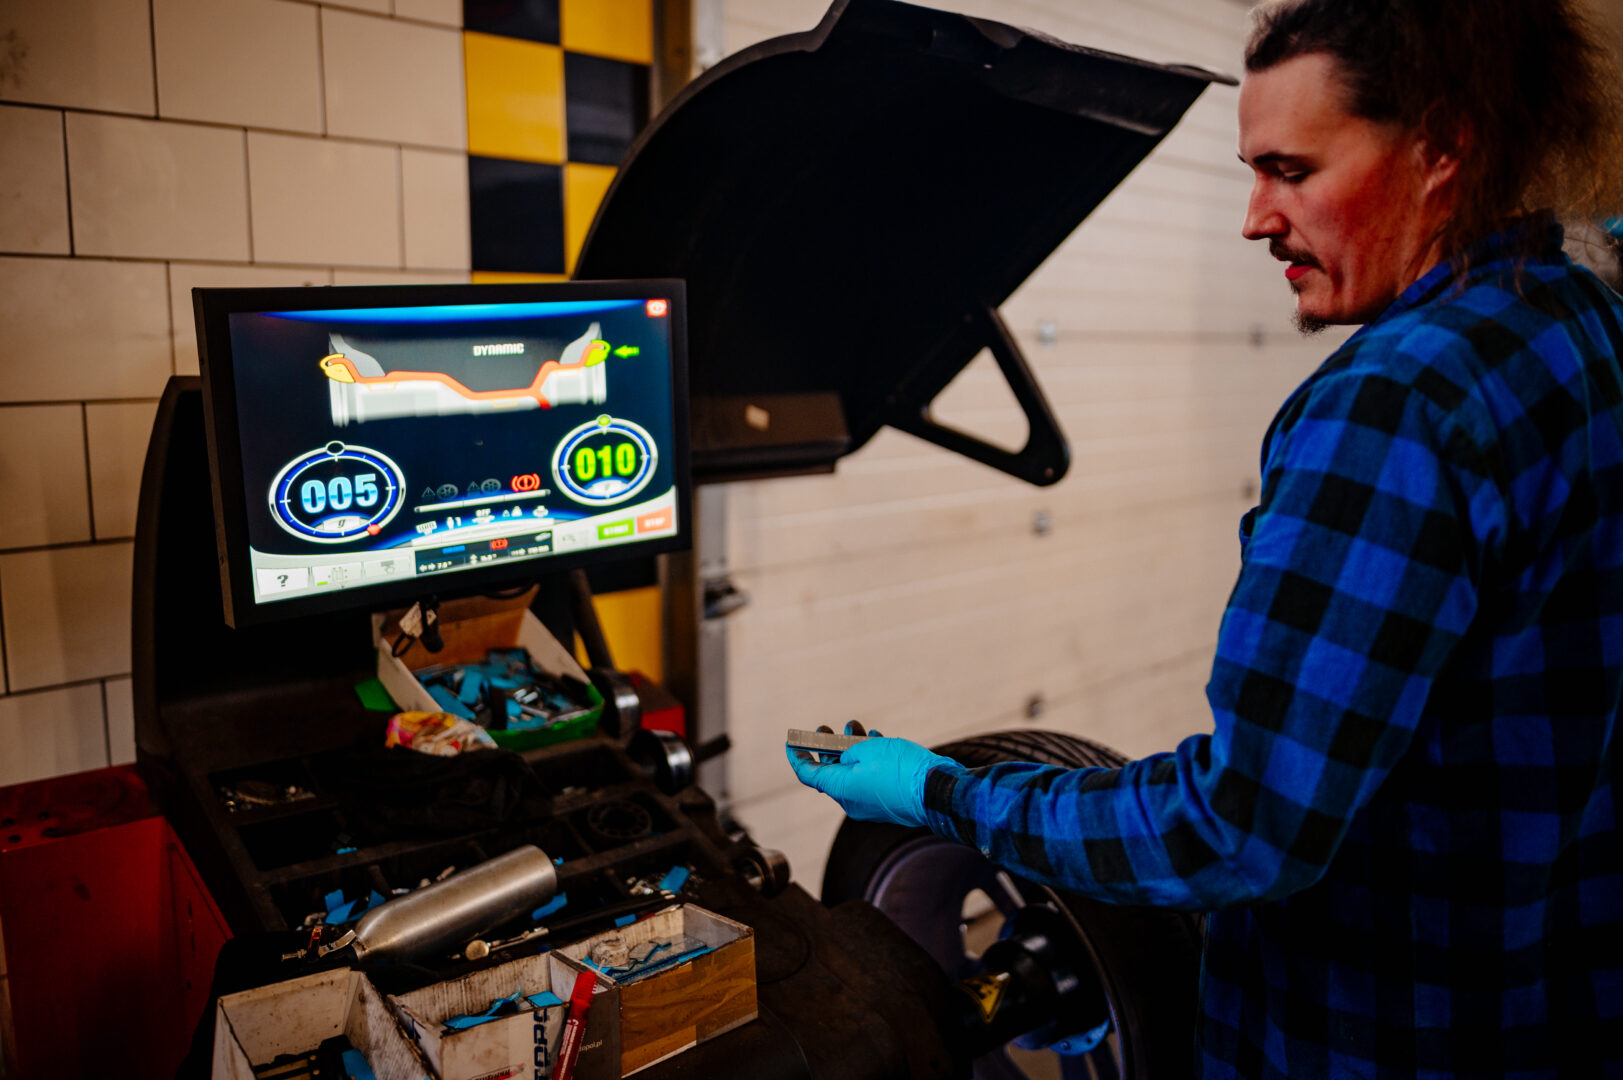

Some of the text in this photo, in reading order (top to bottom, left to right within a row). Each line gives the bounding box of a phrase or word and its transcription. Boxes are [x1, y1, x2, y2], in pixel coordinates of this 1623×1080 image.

[473, 343, 525, 357] DYNAMIC
[575, 442, 636, 481] 010
[301, 473, 379, 514] 005
